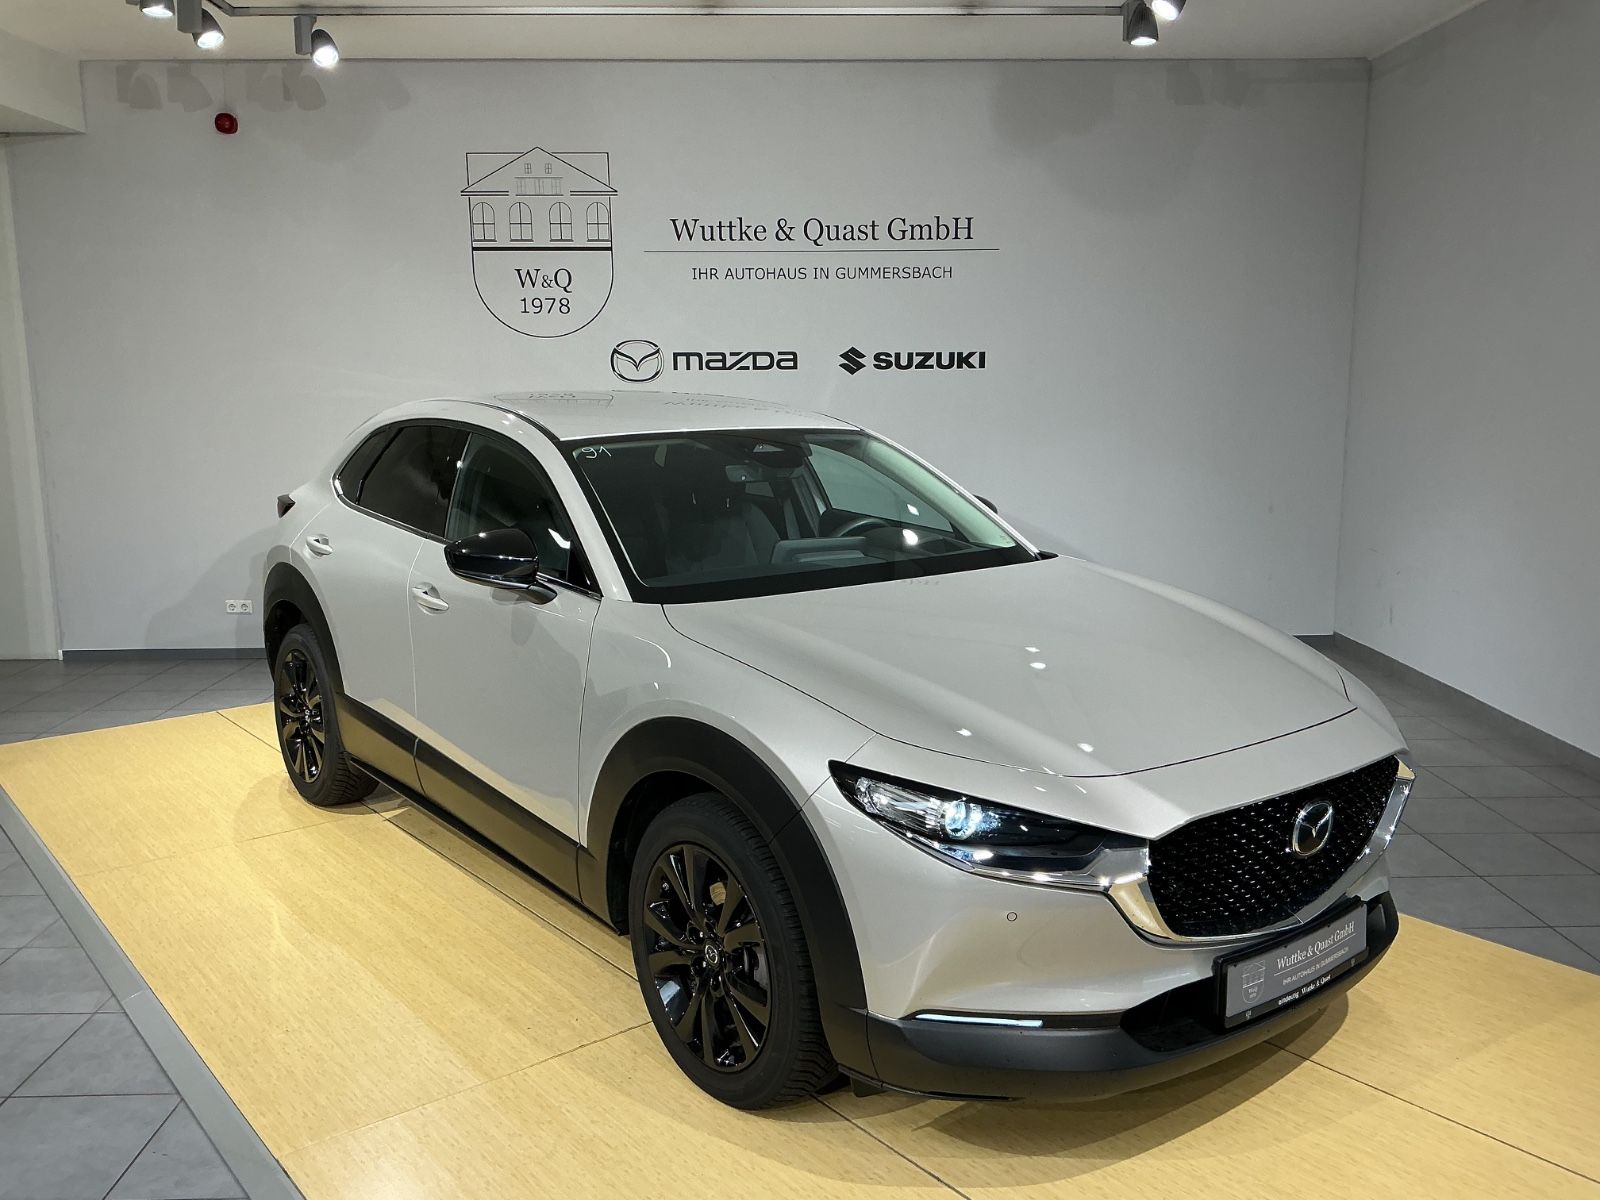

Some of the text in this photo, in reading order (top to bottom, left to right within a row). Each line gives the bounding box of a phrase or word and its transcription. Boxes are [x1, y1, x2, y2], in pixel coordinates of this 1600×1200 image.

[669, 215, 975, 247] Wuttke & Quast GmbH
[514, 267, 573, 293] W&Q
[692, 265, 953, 281] IHR AUTOHAUS IN GUMMERSBACH
[520, 297, 571, 315] 1978
[872, 351, 986, 370] SUZUKI
[581, 446, 612, 459] 91
[1276, 921, 1355, 970] Wuttke & Quast GmbH
